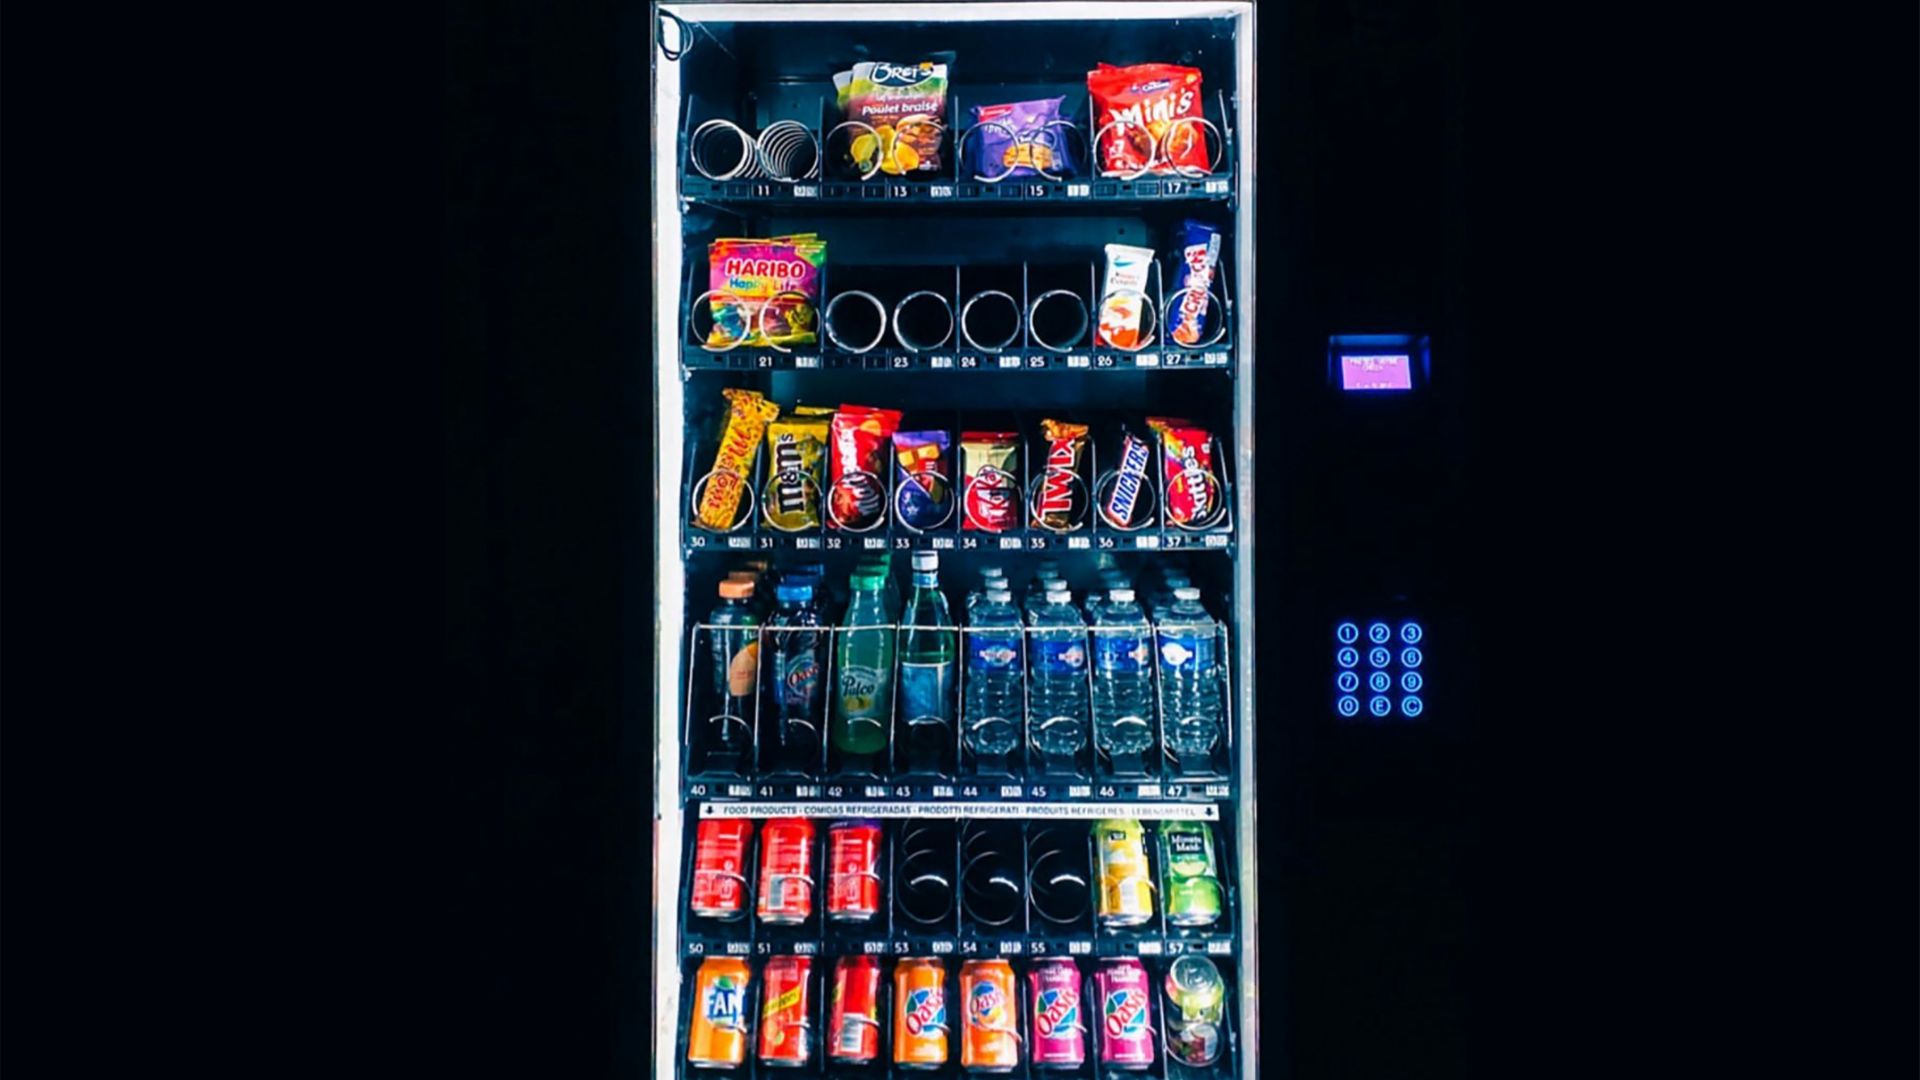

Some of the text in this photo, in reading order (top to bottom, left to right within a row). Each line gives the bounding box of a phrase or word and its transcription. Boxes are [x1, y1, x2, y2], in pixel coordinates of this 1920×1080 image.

[862, 104, 900, 115] Poulet
[1109, 89, 1194, 136] Mini's
[758, 184, 770, 196] 11
[894, 186, 907, 197] 13
[1030, 184, 1044, 197] 15
[1167, 182, 1181, 194] 17
[727, 260, 804, 278] HARIBO
[759, 356, 772, 367] 21
[893, 356, 909, 368] 23
[961, 356, 976, 368] 24
[1030, 356, 1045, 368] 25
[1097, 355, 1113, 367] 26
[1166, 353, 1181, 365] 27
[1041, 439, 1075, 520] TWIX
[1112, 438, 1149, 520] SNICKERS
[691, 536, 706, 548] 30
[761, 537, 773, 549] 31
[827, 537, 841, 549] 32
[963, 537, 977, 549] 34
[1031, 537, 1046, 549] 35
[1099, 537, 1114, 549] 36
[1167, 535, 1181, 548] 37
[842, 675, 875, 698] Pulco
[690, 785, 706, 796] 40
[760, 786, 773, 797] 41
[896, 786, 911, 797] 43
[963, 786, 978, 797] 44
[1031, 786, 1047, 797] 45
[1099, 786, 1115, 797] 46
[1167, 784, 1183, 797] 47
[723, 806, 749, 815] FOOD
[750, 806, 797, 815] PRODUCTS
[804, 805, 844, 815] COMIDAS
[845, 805, 911, 815] REFRIGERADAS
[918, 805, 962, 814] PRODOTTI
[963, 805, 1019, 814] REFRIGERATI
[1026, 806, 1069, 815] PRODUITS
[688, 943, 704, 954] 50
[757, 942, 771, 954] 51
[894, 942, 909, 953] 53
[962, 941, 977, 953] 54
[1031, 942, 1046, 953] 55
[1037, 989, 1078, 1036] Oasis
[1107, 990, 1147, 1036] Oasis
